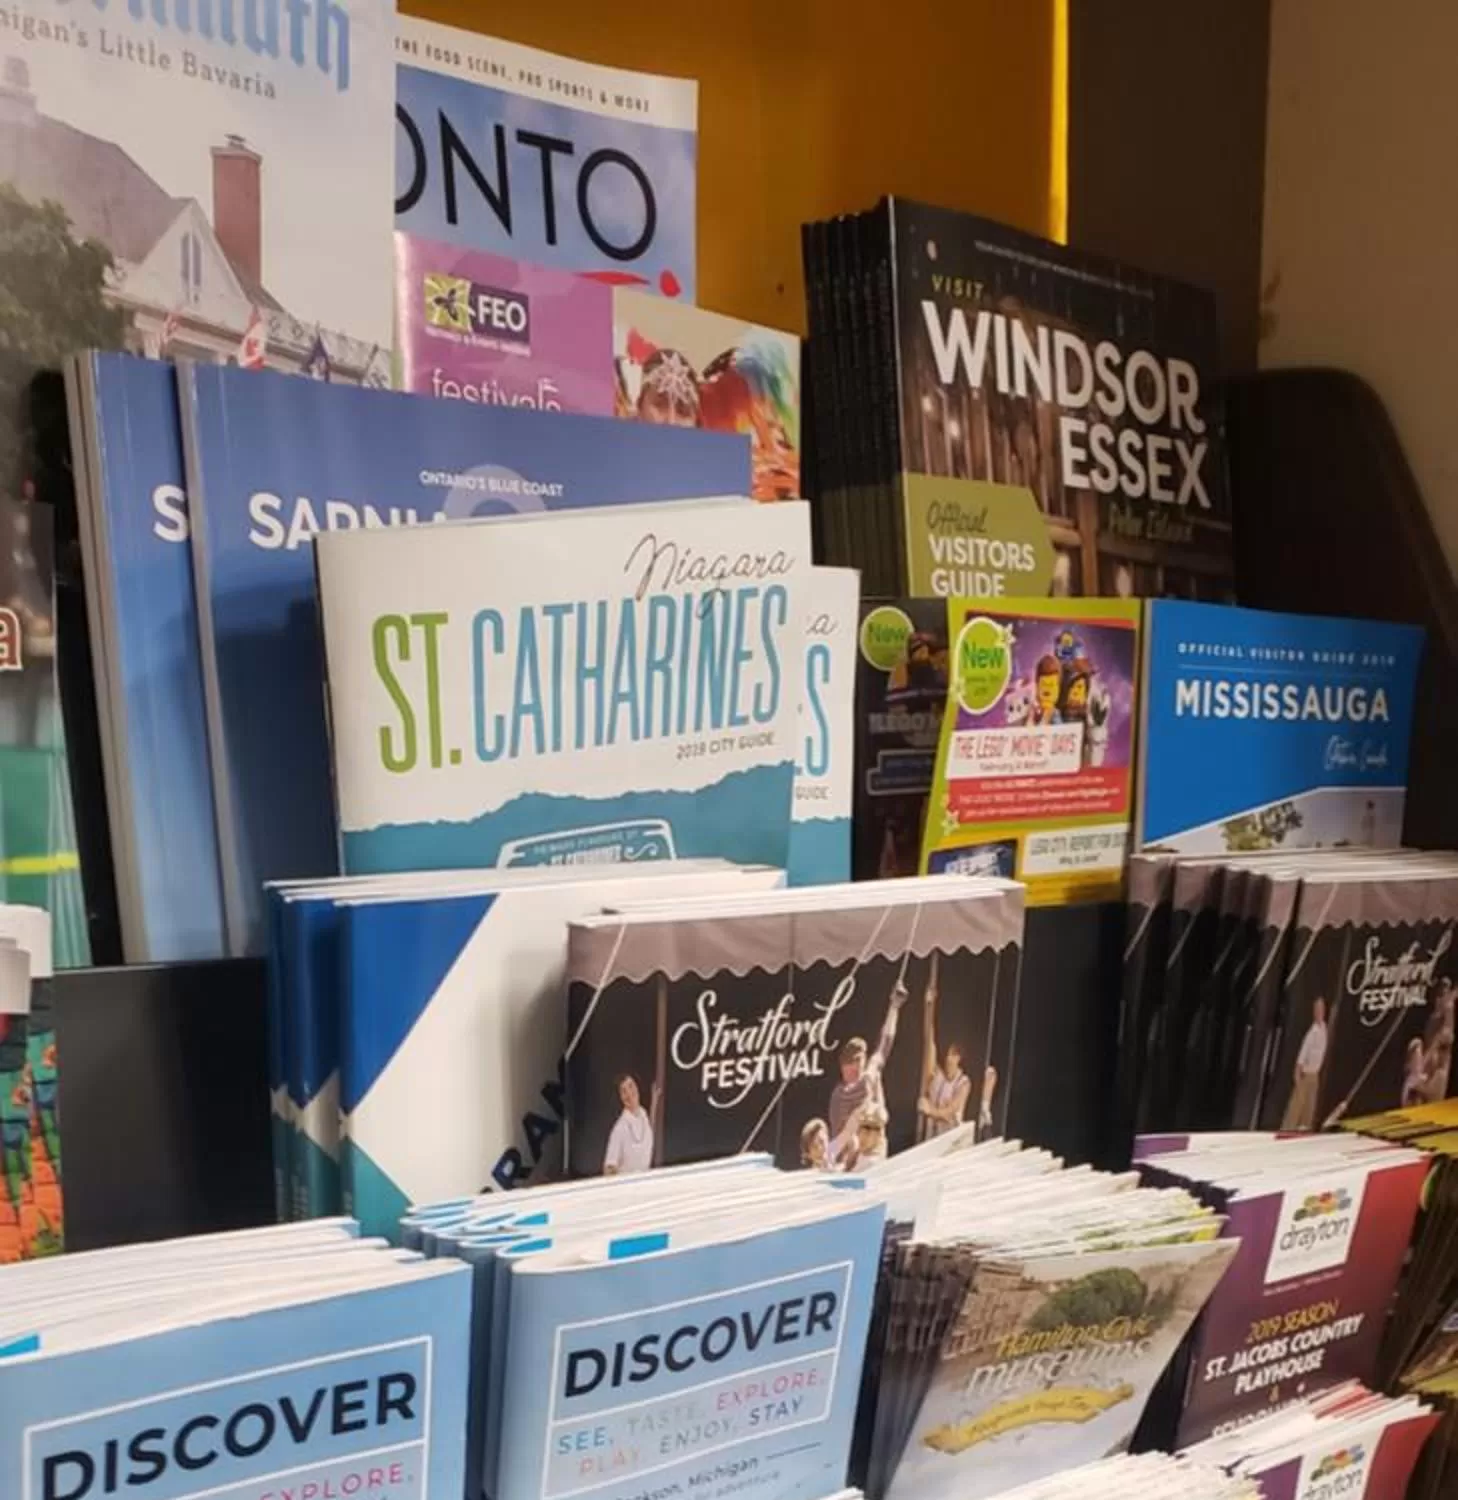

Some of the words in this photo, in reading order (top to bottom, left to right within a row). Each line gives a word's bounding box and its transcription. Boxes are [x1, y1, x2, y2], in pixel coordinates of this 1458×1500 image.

[100, 28, 172, 71] Little
[183, 50, 277, 100] Bavaria
[426, 44, 461, 67] FOOD
[519, 69, 543, 89] PRO
[932, 275, 985, 299] VISIT
[478, 295, 527, 332] FEO
[922, 300, 1206, 434] WINDSOR
[1060, 416, 1211, 508] ESSEX
[488, 477, 520, 494] BLUE
[521, 480, 563, 497] COAST
[926, 502, 988, 535] Official
[928, 535, 1036, 572] VISITORS
[625, 533, 795, 622] Niagara
[931, 567, 1006, 598] GUIDE
[962, 641, 1005, 669] New
[1178, 642, 1244, 658] OFFICIAL
[1251, 647, 1305, 661] VISITOR
[1312, 650, 1355, 665] GUIDE
[372, 612, 462, 774] ST.
[472, 584, 788, 763] CATHARINES
[1175, 678, 1390, 722] MISSISSAUGA
[709, 737, 736, 754] CITY
[739, 731, 775, 750] GUIDE
[1347, 927, 1452, 996] Stratford
[1360, 984, 1428, 1016] FESTIVAL
[671, 976, 854, 1070] Stratford
[702, 1050, 824, 1098] FESTIVAL
[1280, 1217, 1350, 1251] drayton
[997, 1322, 1102, 1359] Hamilton
[1247, 1315, 1284, 1343] 2019
[1285, 1300, 1341, 1332] SEASON
[565, 1290, 838, 1400] DISCOVER
[966, 1340, 1152, 1393] museums
[1204, 1357, 1228, 1382] ST.
[1230, 1335, 1290, 1374] JACOBS
[1291, 1312, 1365, 1353] COUNTRY
[1234, 1349, 1326, 1396] PLAYHOUSE
[748, 1394, 804, 1427] STAY
[687, 1456, 760, 1488] Michigan
